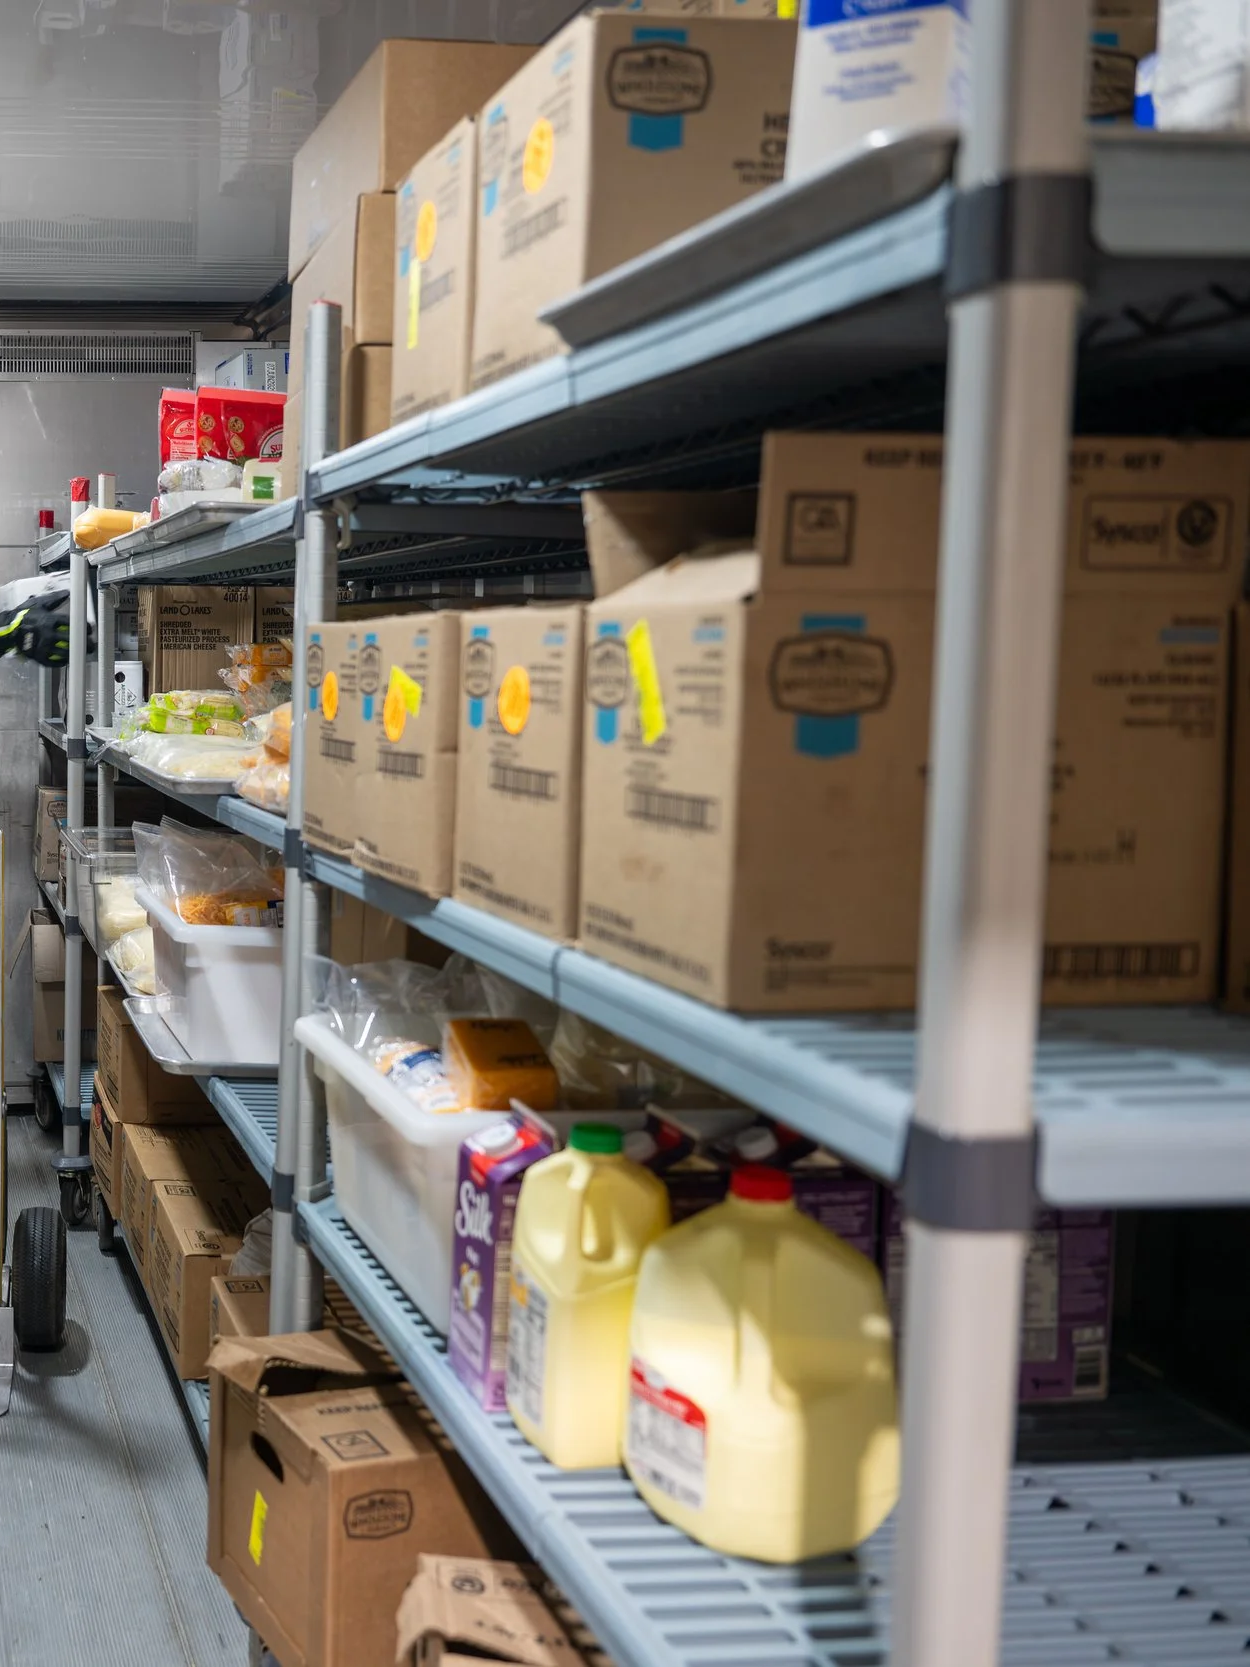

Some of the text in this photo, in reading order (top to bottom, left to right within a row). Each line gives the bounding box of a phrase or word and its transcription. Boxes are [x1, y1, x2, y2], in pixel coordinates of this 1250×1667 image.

[159, 606, 179, 615] LAND
[191, 606, 211, 615] LAKES
[159, 628, 180, 636] EXTRA
[201, 628, 221, 636] WHITE
[159, 635, 230, 643] PASTEURIZED PROCESS
[159, 643, 217, 651] AMERICAN CHEESE
[454, 1180, 496, 1247] Silk
